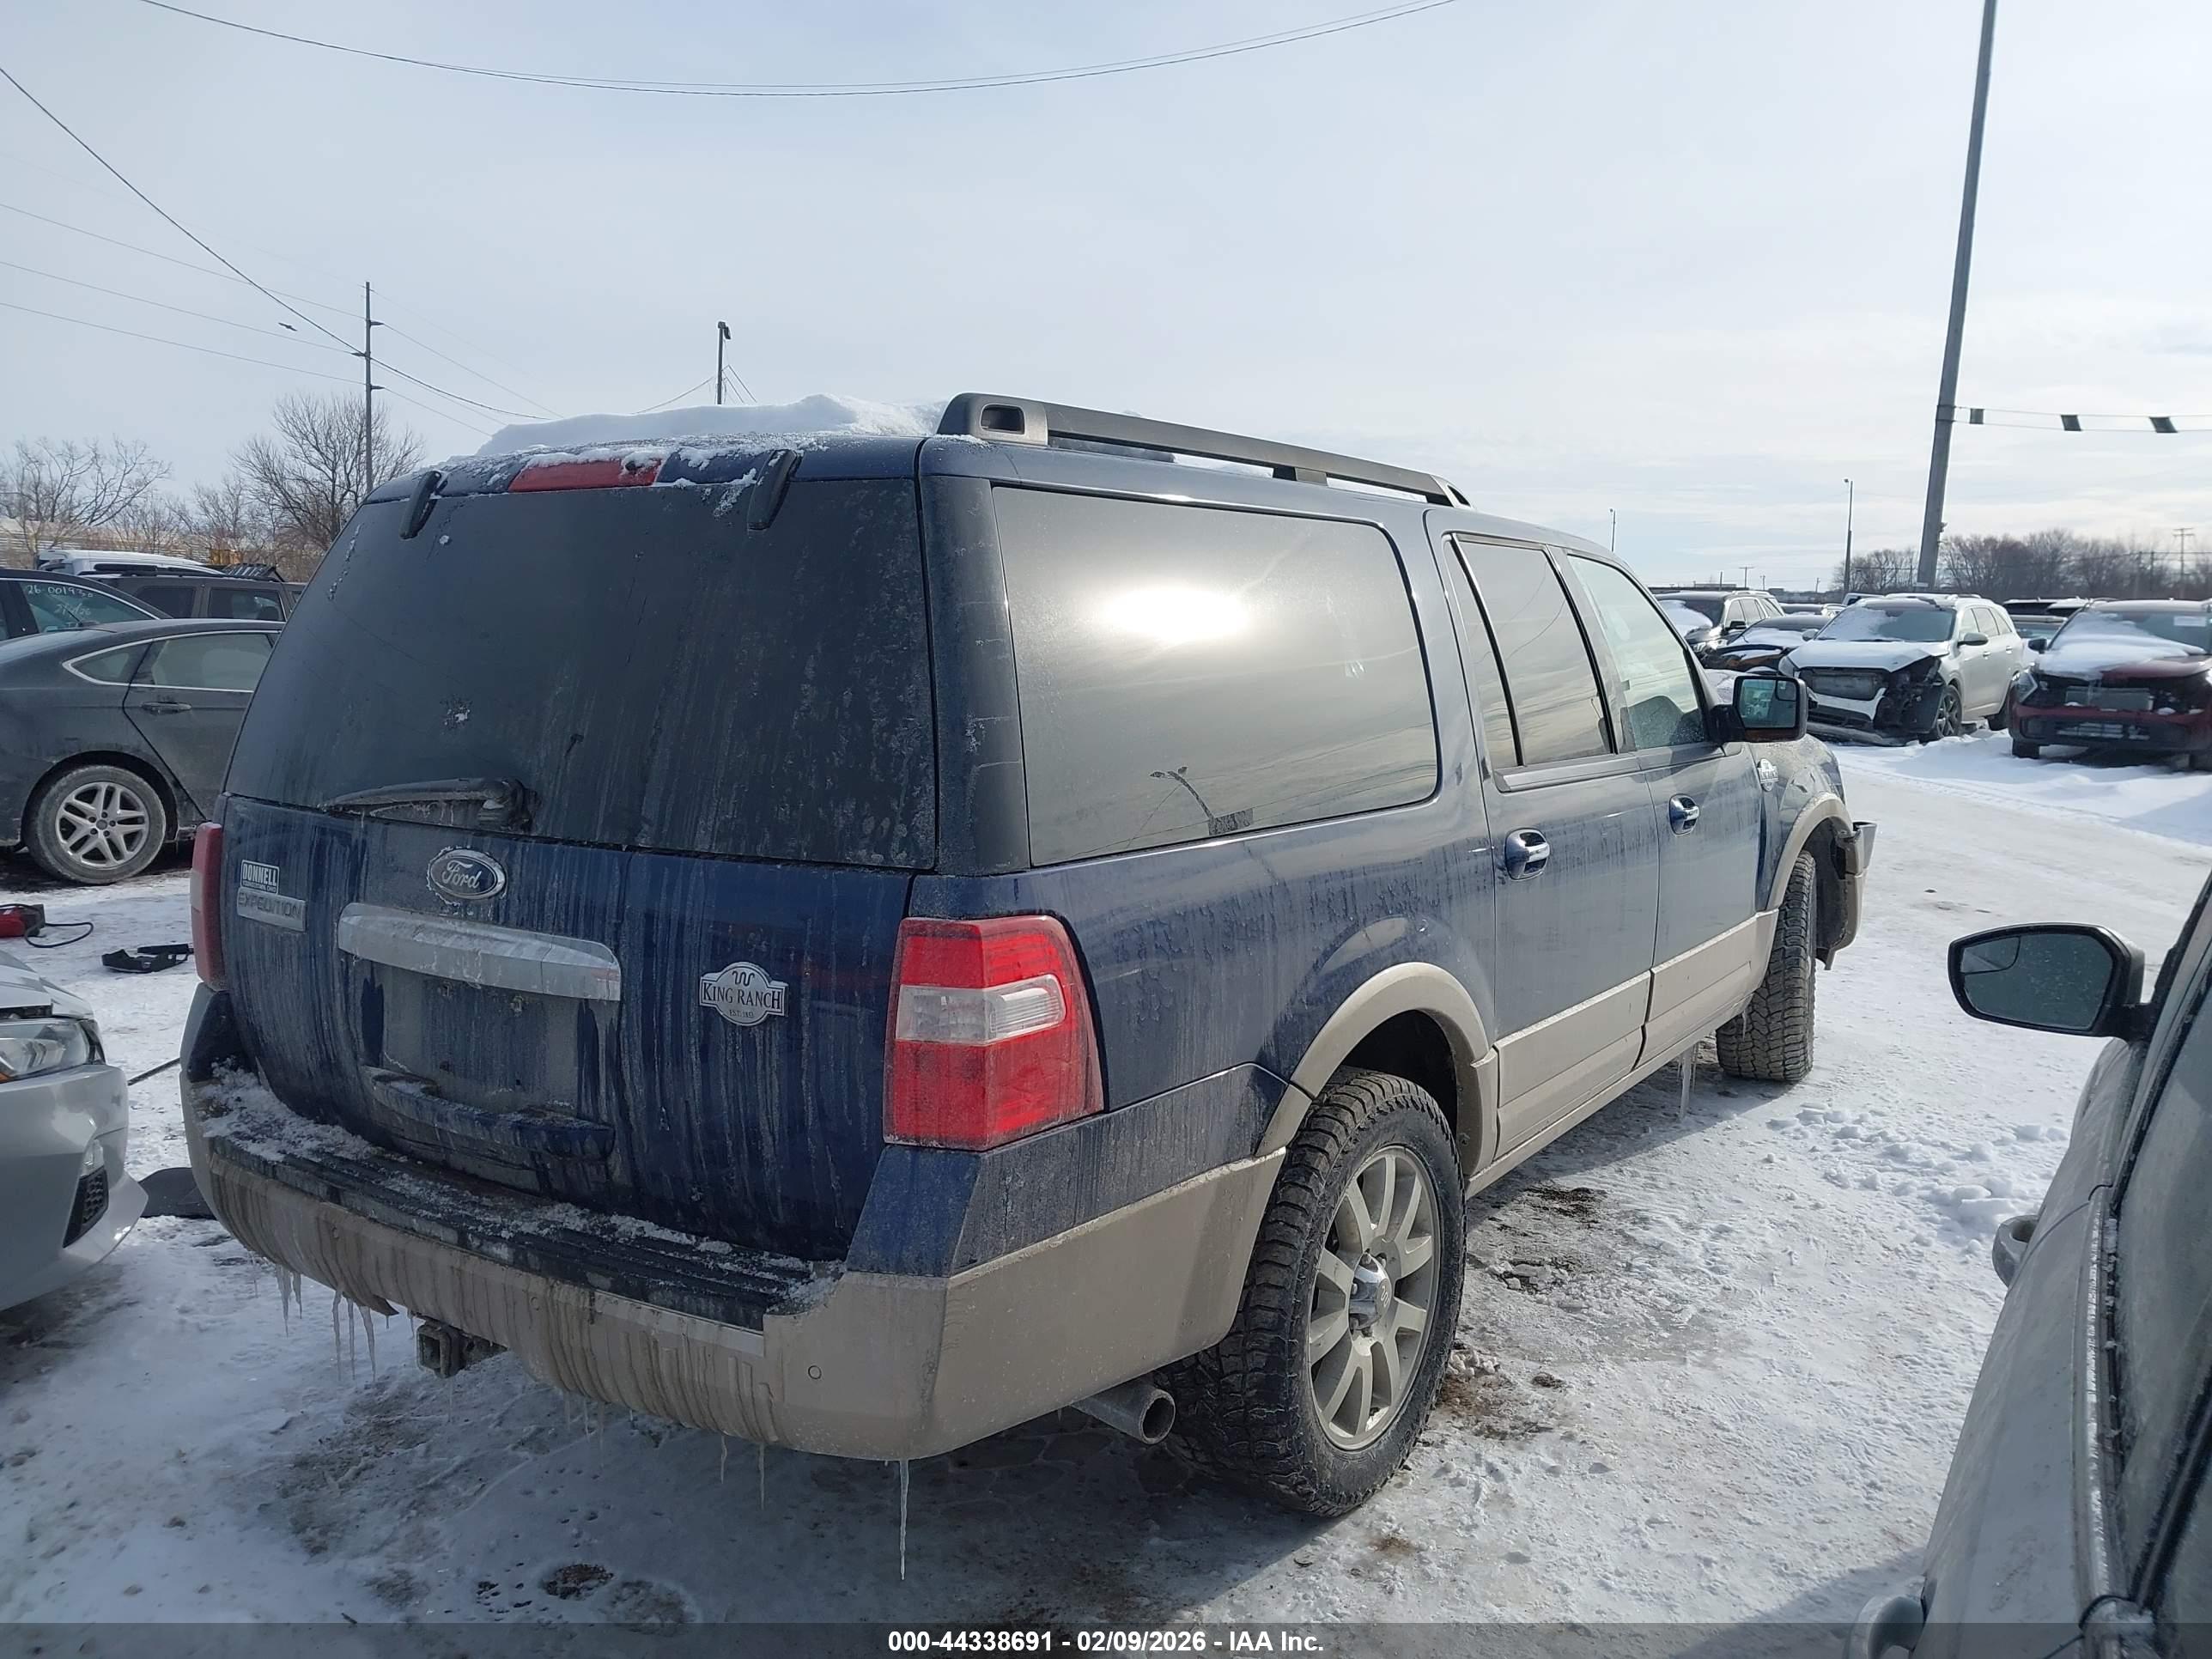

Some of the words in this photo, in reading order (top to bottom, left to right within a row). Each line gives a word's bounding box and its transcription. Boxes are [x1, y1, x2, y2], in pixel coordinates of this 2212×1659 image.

[242, 864, 277, 886] DONNELL
[441, 860, 482, 889] Ford
[703, 982, 733, 1004] KING
[737, 988, 781, 1010] RANCH
